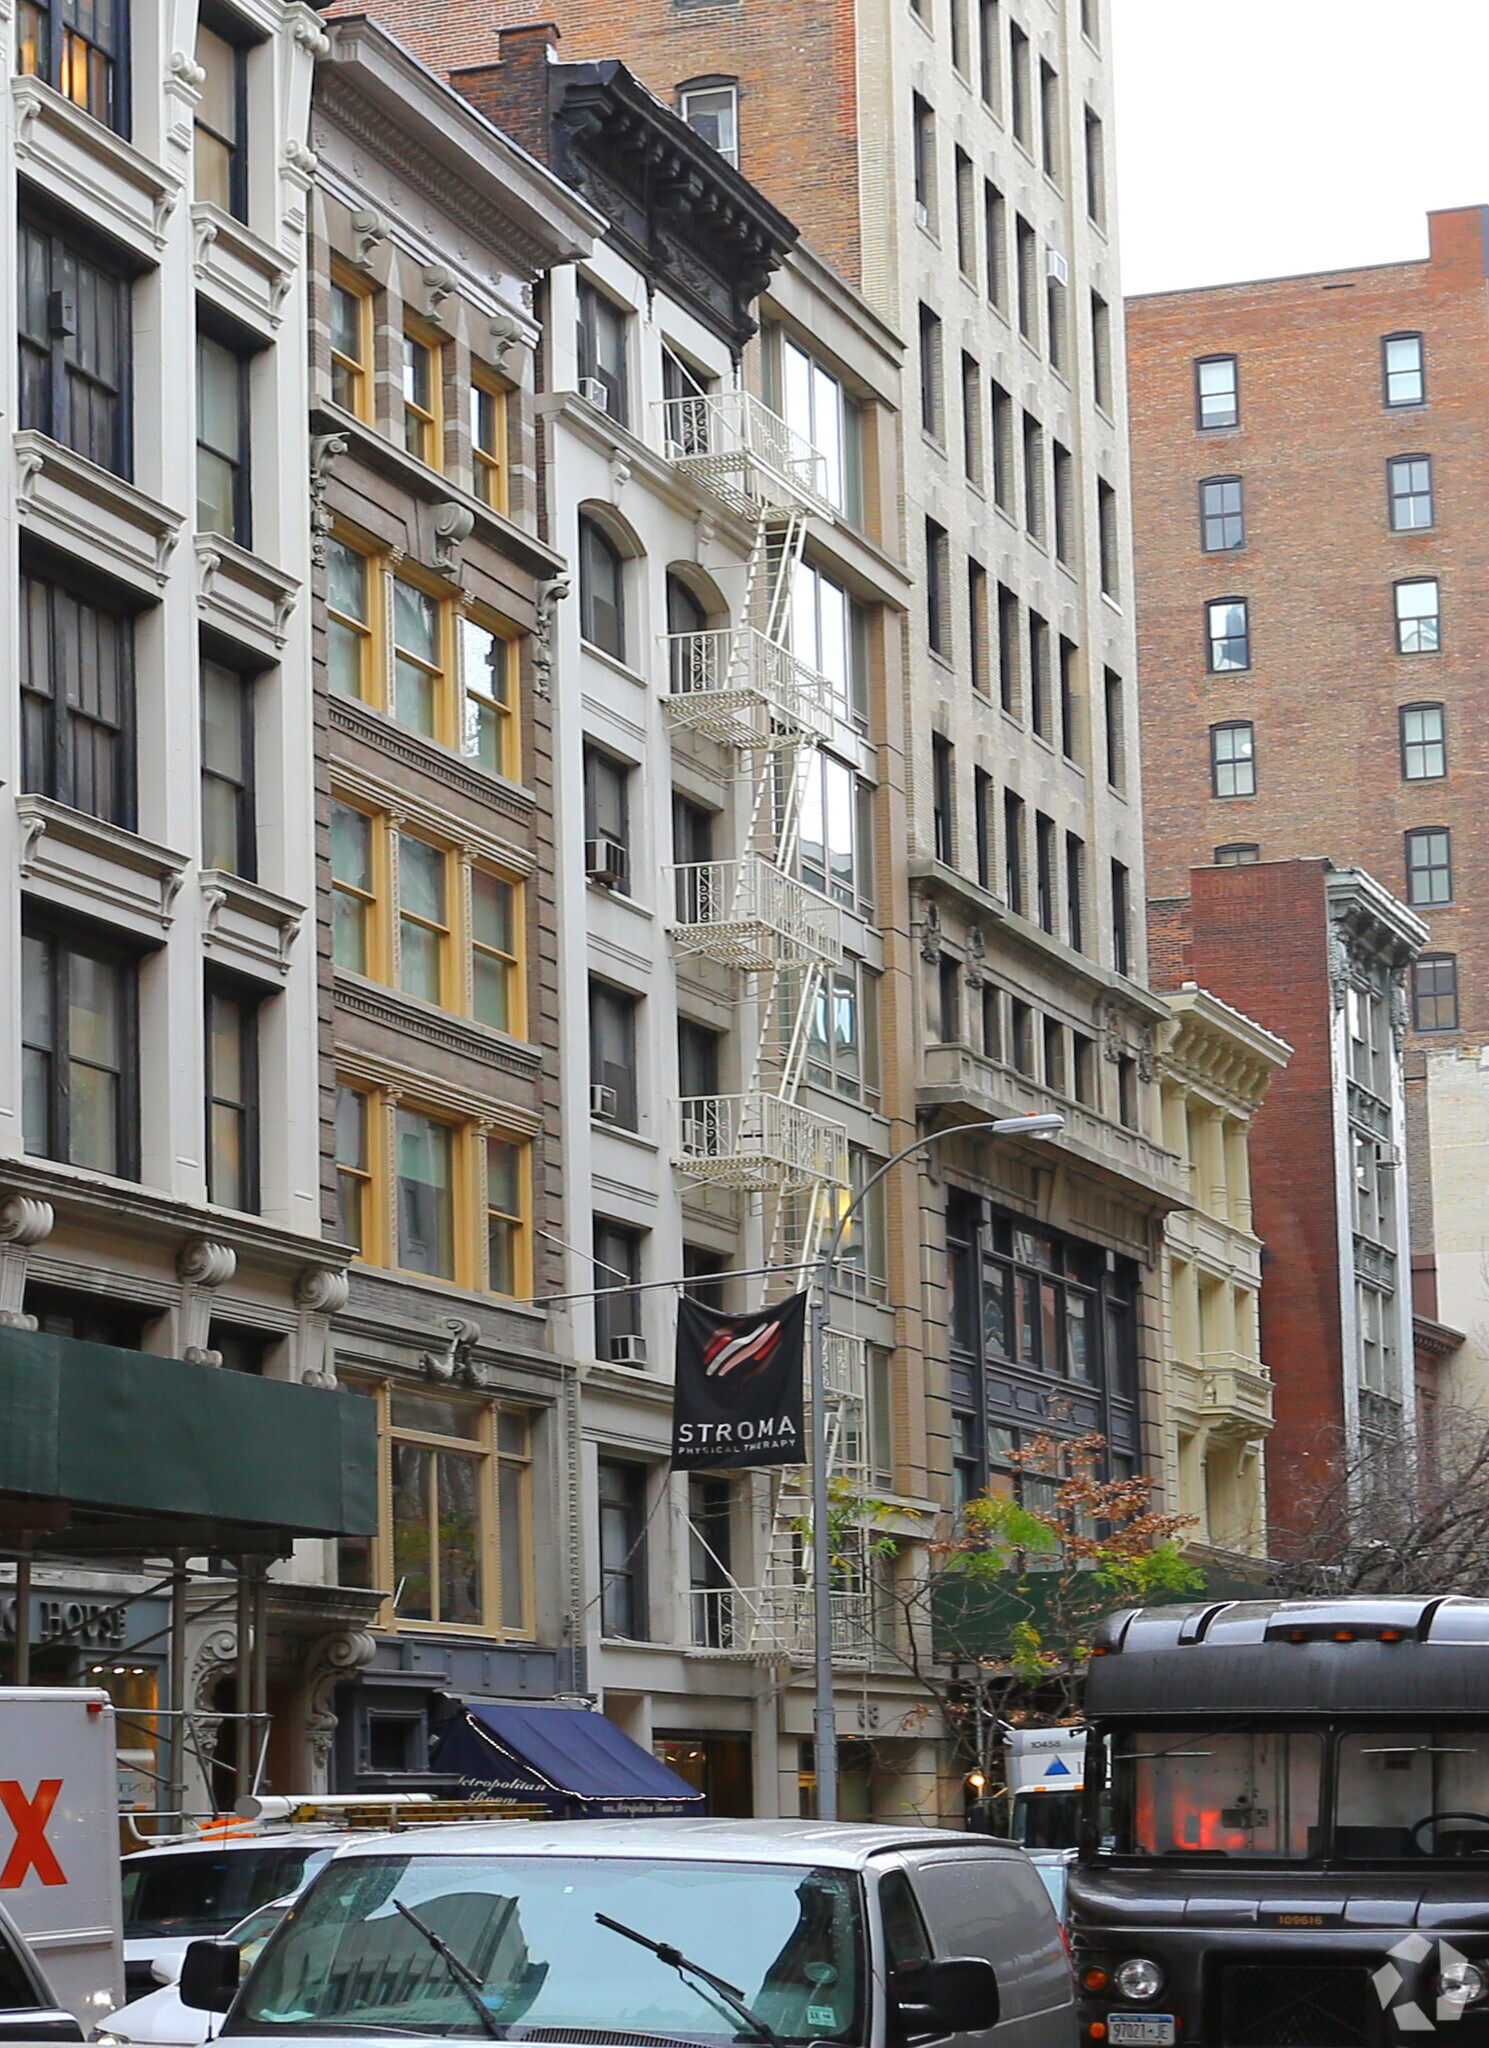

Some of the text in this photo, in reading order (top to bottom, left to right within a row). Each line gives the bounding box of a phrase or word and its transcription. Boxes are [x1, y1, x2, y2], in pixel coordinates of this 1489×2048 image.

[678, 1415, 797, 1443] STROMA
[678, 1439, 796, 1455] PHYSICAL THERAPY
[40, 1601, 127, 1639] HOUSE
[1279, 1915, 1323, 1925] 109616
